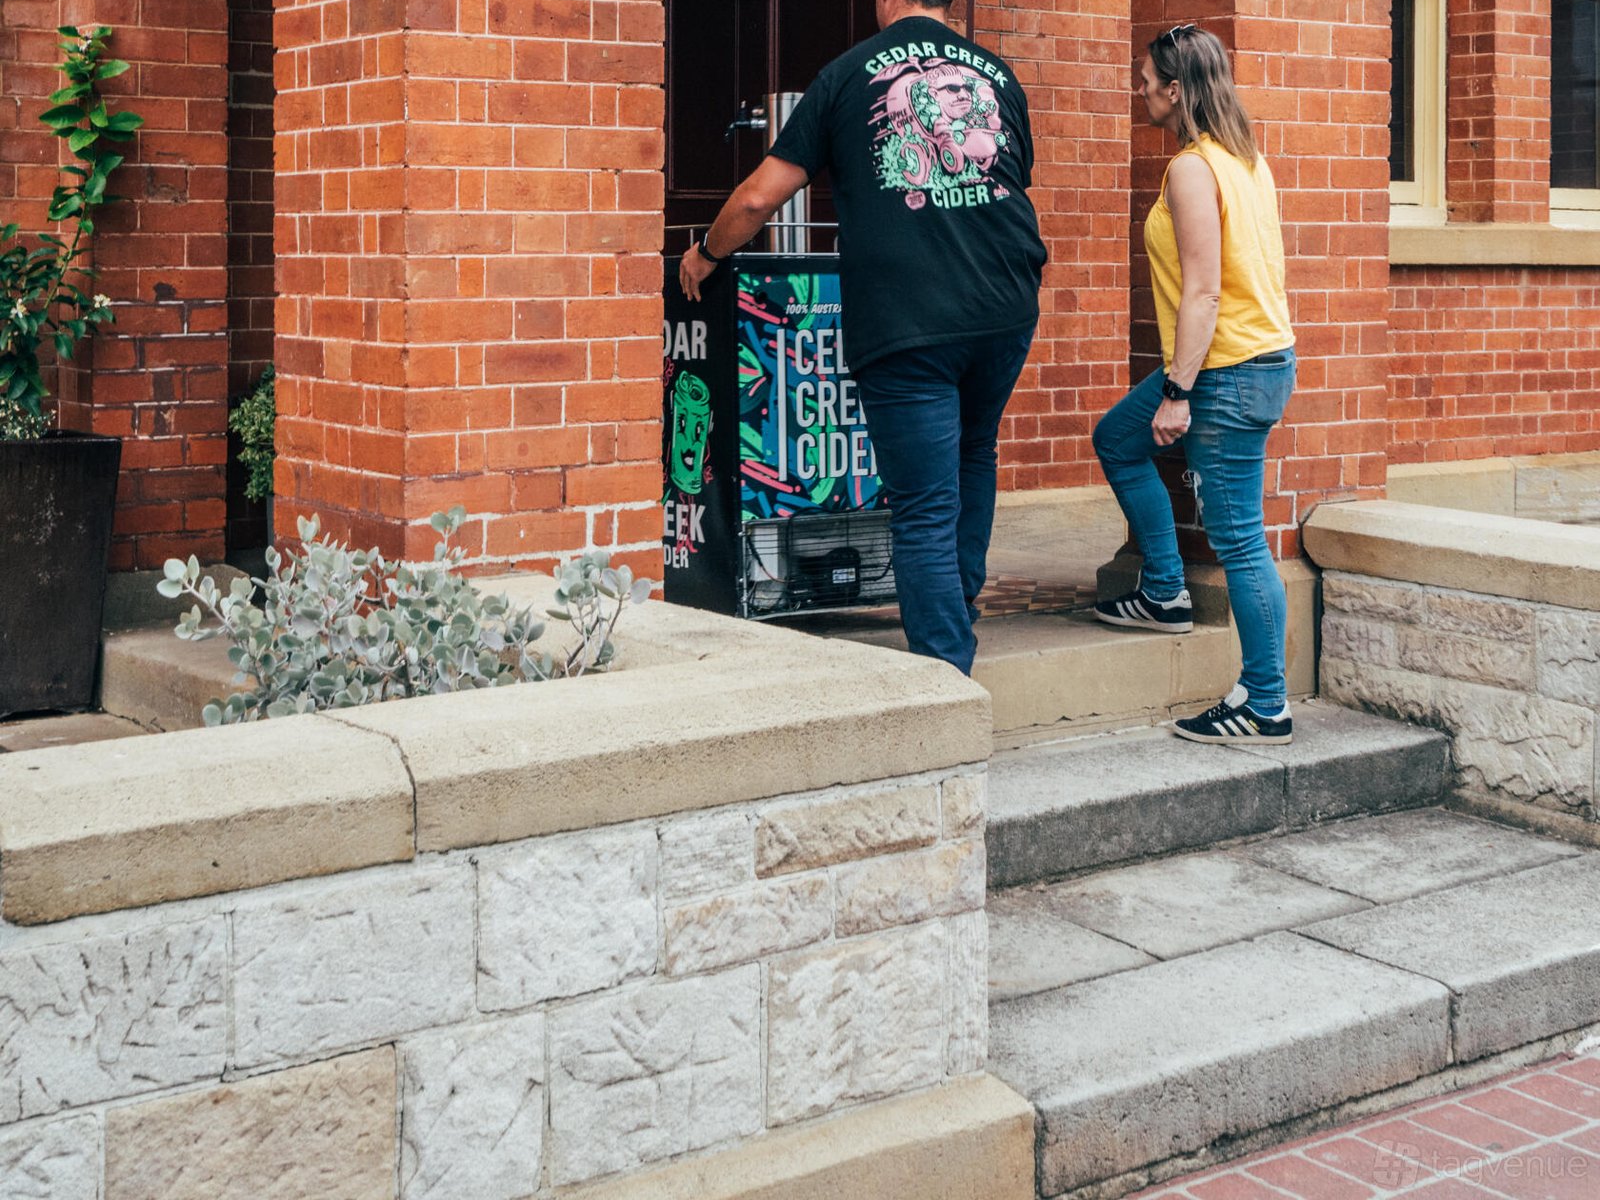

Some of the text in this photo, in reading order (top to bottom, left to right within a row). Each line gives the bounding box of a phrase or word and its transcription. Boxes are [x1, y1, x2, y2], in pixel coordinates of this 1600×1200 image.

[865, 41, 1009, 89] CEDAR CREEK
[931, 184, 990, 209] CIDER
[785, 304, 808, 315] 100%
[796, 380, 867, 427] CRE
